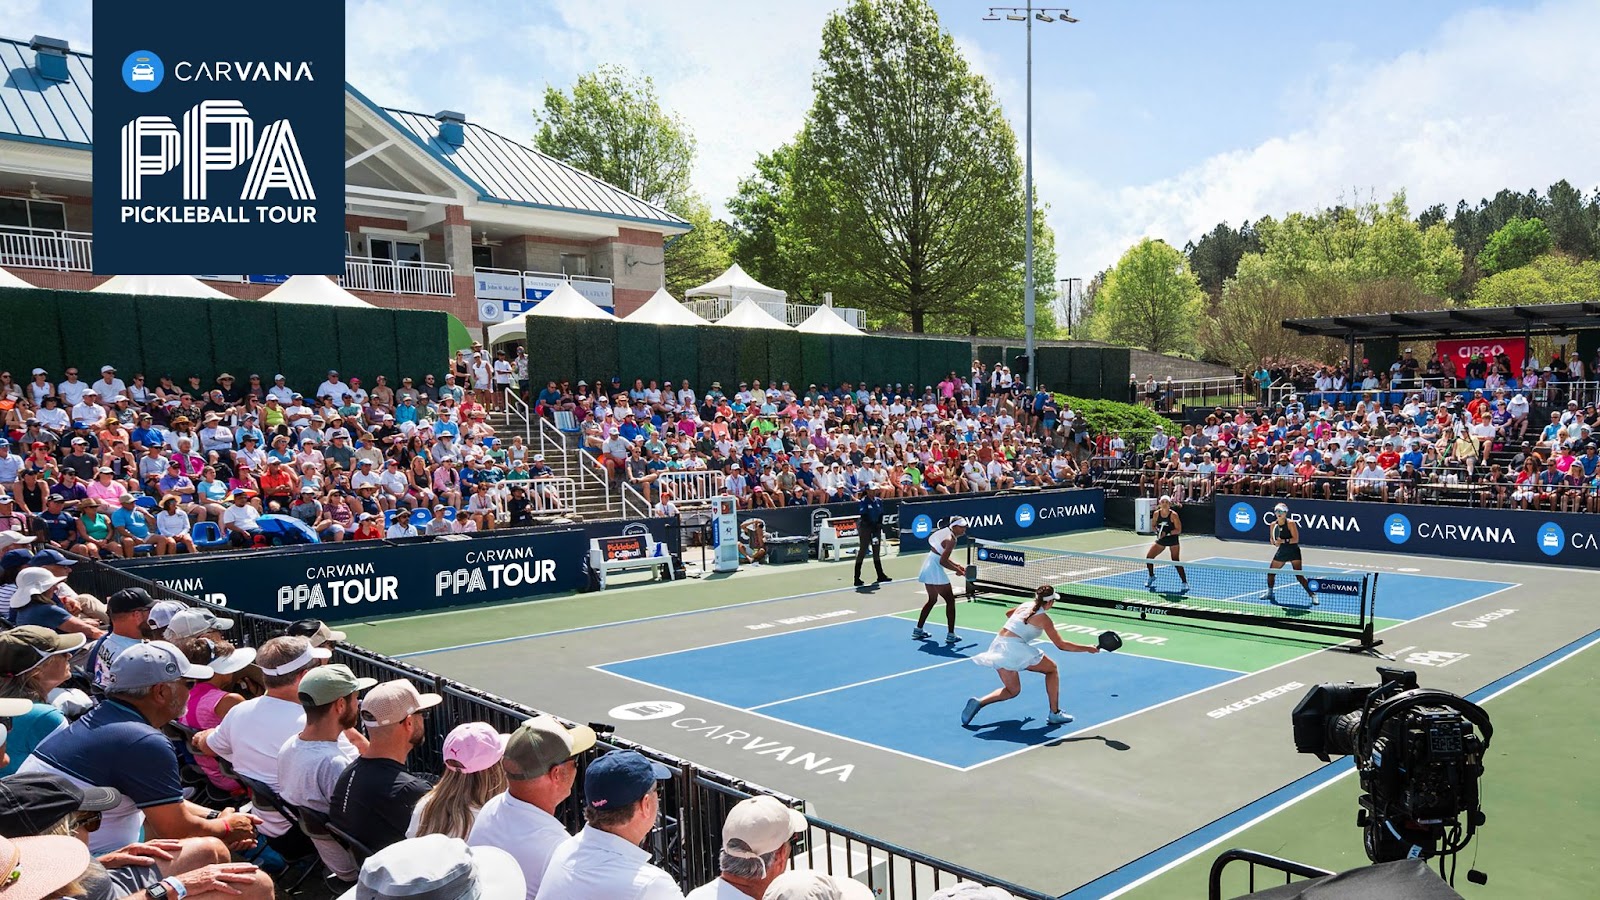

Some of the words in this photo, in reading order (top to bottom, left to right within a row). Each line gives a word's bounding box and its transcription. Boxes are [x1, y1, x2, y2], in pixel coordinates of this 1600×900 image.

[1039, 504, 1096, 520] CARVANA
[937, 514, 1004, 530] CVANA
[1263, 511, 1360, 532] CRVANA
[1418, 523, 1516, 544] CARVANA
[607, 541, 640, 551] Pickleball
[466, 547, 534, 564] CARVANA
[989, 552, 1024, 562] CARVANA
[306, 563, 375, 579] CARVANA
[435, 567, 487, 597] PPA
[487, 559, 557, 589] TOUR
[277, 583, 327, 613] PPA
[328, 576, 399, 607] TOUR
[1321, 583, 1358, 592] CARVANA
[1206, 681, 1306, 719] SKECHERS
[671, 717, 856, 783] CARVANA
